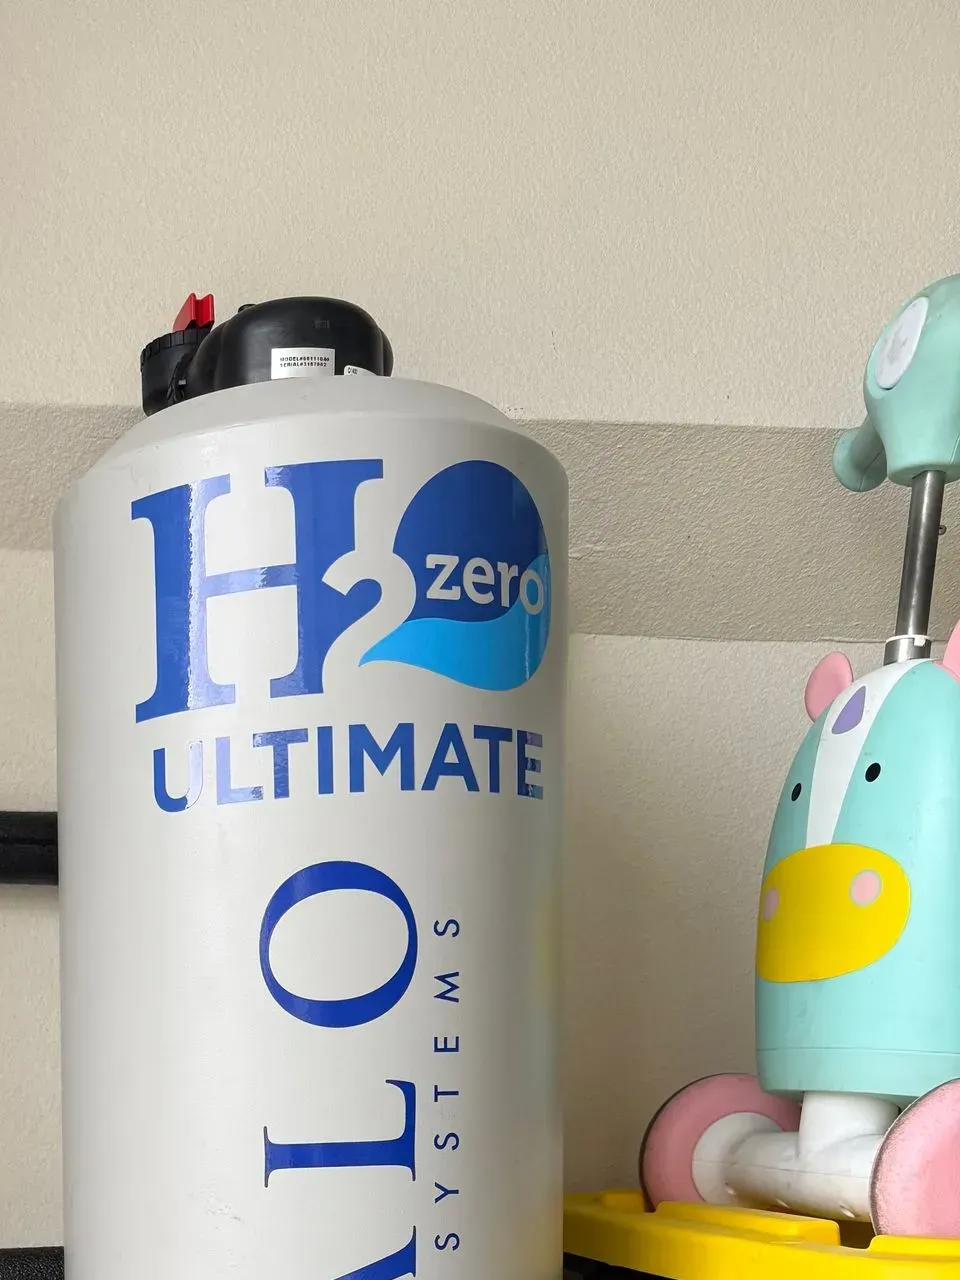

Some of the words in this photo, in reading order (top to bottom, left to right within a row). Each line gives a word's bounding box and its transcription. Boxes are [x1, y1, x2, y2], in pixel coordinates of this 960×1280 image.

[424, 553, 545, 616] zero
[153, 722, 544, 813] ULTIMATE
[433, 918, 460, 1251] SYSTEMS
